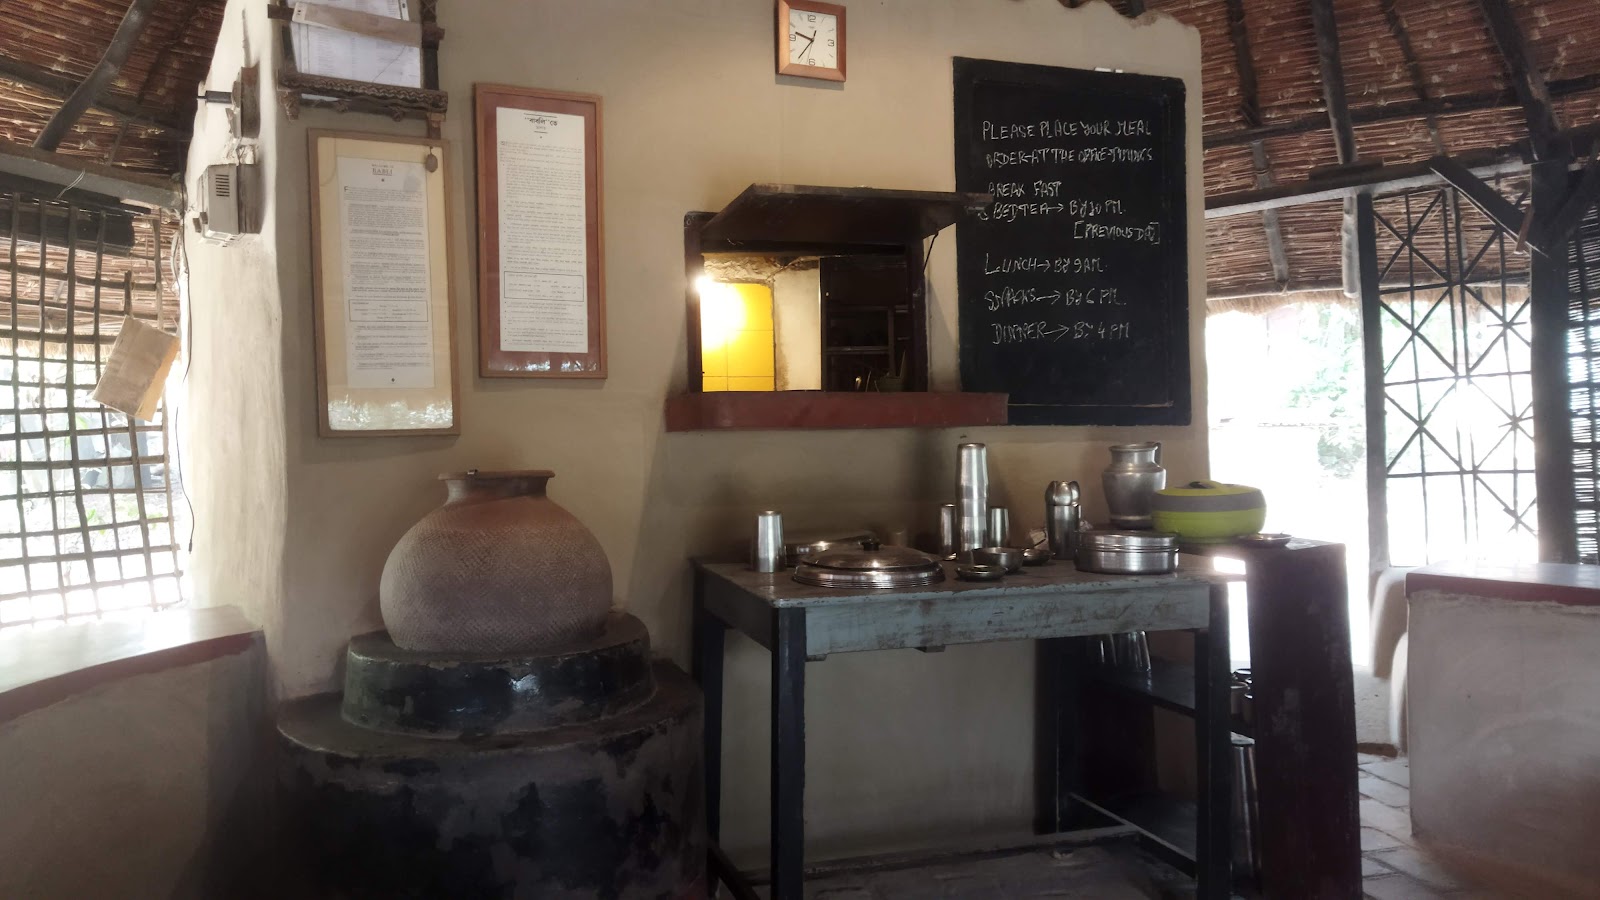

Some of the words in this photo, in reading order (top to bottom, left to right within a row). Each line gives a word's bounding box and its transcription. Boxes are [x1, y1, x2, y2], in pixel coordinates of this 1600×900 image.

[808, 14, 816, 22] 12
[828, 39, 835, 47] 3
[809, 58, 815, 66] 6
[982, 120, 1036, 140] PLEASE
[1039, 119, 1078, 139] PLACE
[1079, 120, 1112, 137] YOUR
[1114, 119, 1153, 137] MEAL
[1051, 147, 1076, 164] THE
[988, 181, 1026, 198] BREAK
[1033, 179, 1063, 198] FAST
[1069, 199, 1088, 218] BY
[983, 253, 1038, 275] LUNCH
[1053, 256, 1071, 274] BY
[1065, 288, 1083, 306] BY
[1085, 287, 1096, 304] 6
[990, 320, 1048, 345] DINNER
[1073, 321, 1094, 339] BY
[1097, 321, 1106, 339] 4
[1109, 321, 1130, 340] PM
